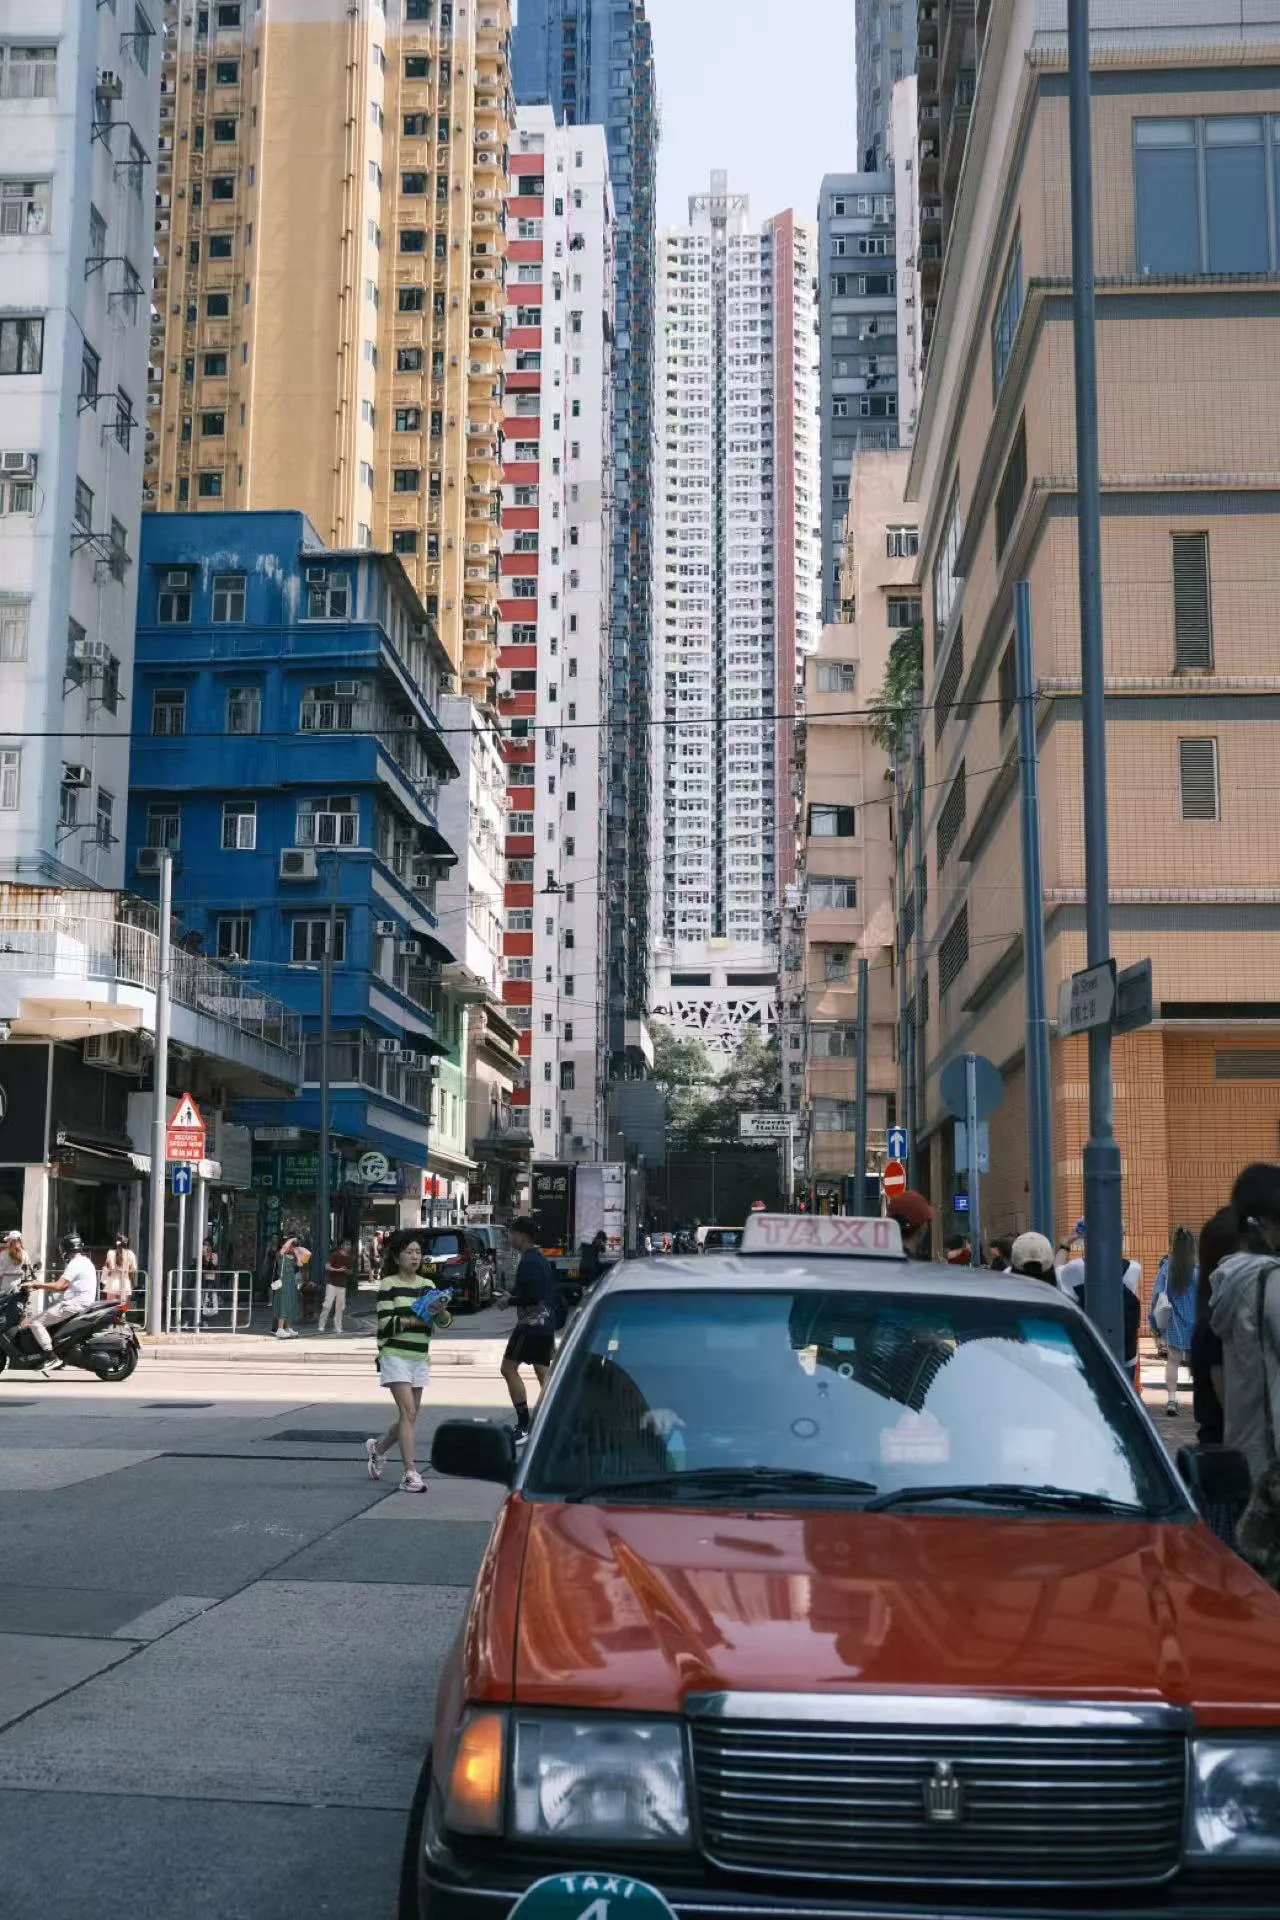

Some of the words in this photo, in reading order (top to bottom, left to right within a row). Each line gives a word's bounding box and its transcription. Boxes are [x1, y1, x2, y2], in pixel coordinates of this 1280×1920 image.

[1080, 975, 1097, 994] Street
[757, 1216, 890, 1249] TAXI
[560, 1875, 636, 1899] TAXI
